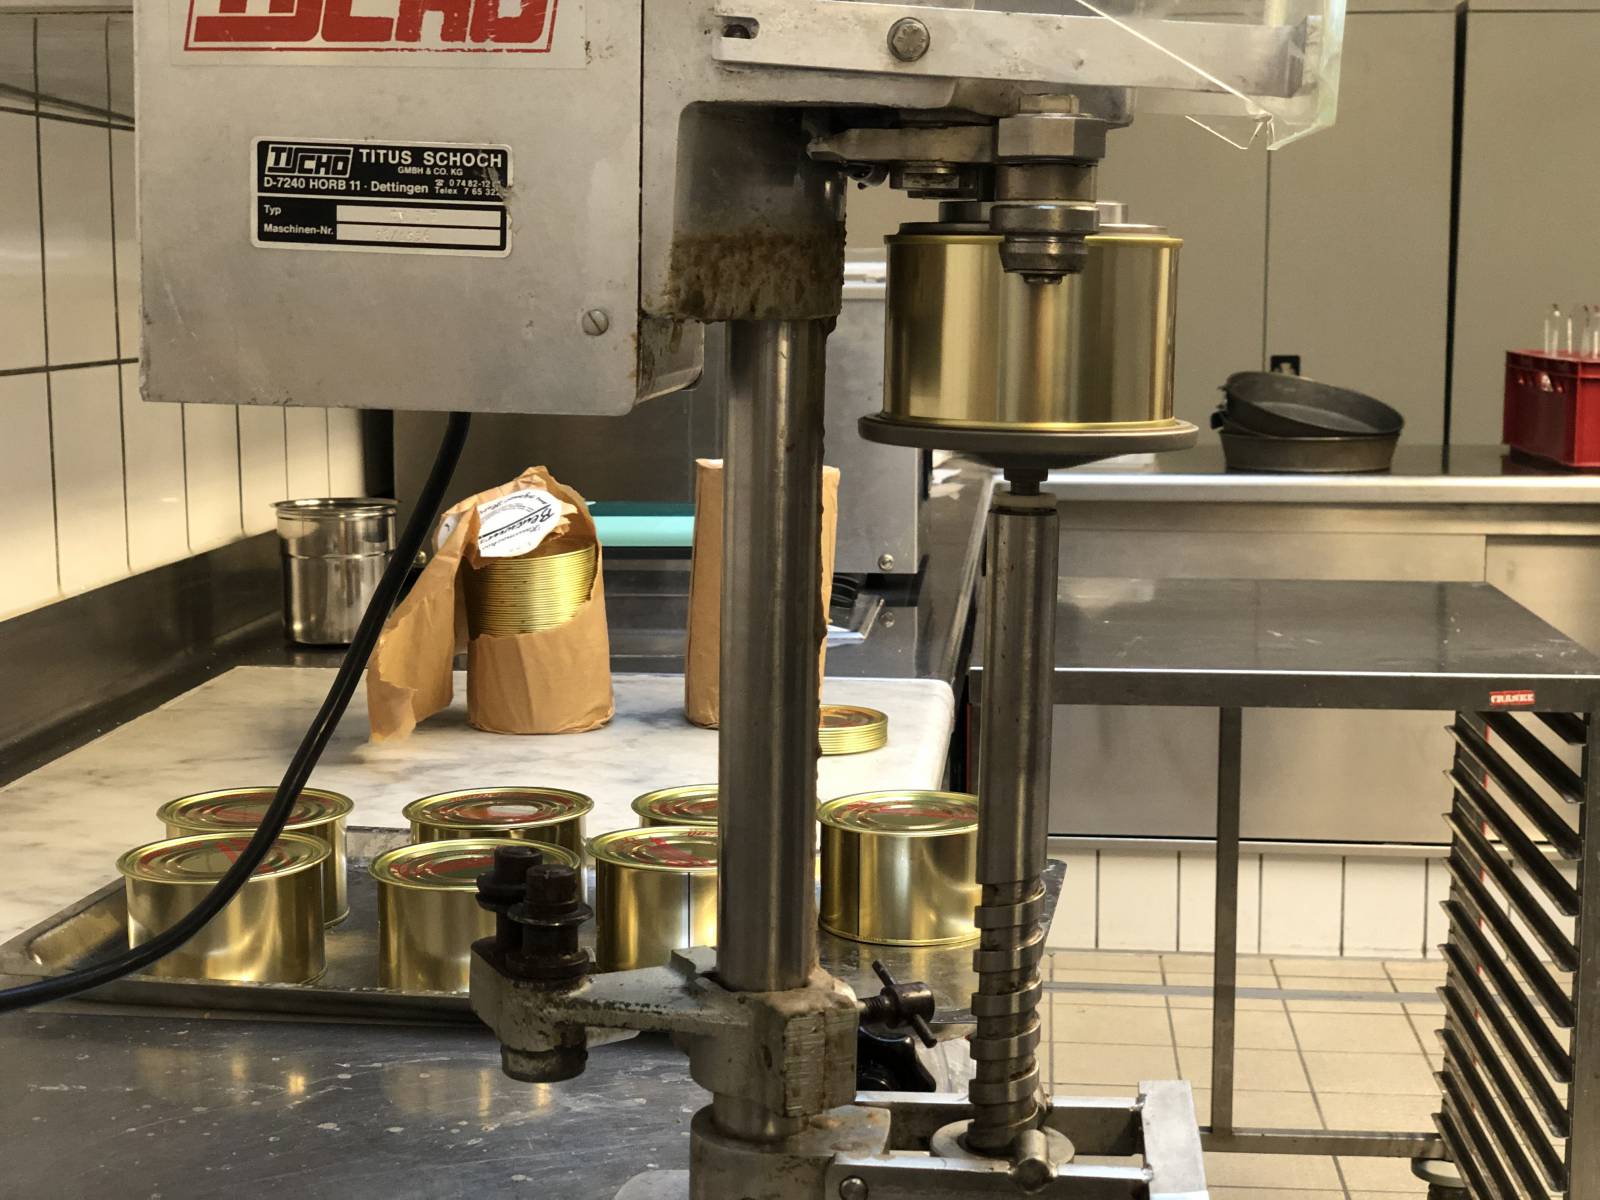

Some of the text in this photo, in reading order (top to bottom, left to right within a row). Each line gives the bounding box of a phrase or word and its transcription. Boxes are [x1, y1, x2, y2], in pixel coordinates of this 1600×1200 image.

[359, 149, 502, 168] TITUS SCHOCH
[397, 167, 424, 175] GMBH
[433, 168, 449, 176] CO.
[451, 168, 464, 176] KG
[263, 176, 429, 195] D-7240 HORB 11 Dettingen
[434, 186, 458, 195] Telex
[263, 204, 282, 216] Typ
[263, 223, 335, 236] Maschinen-Nr.
